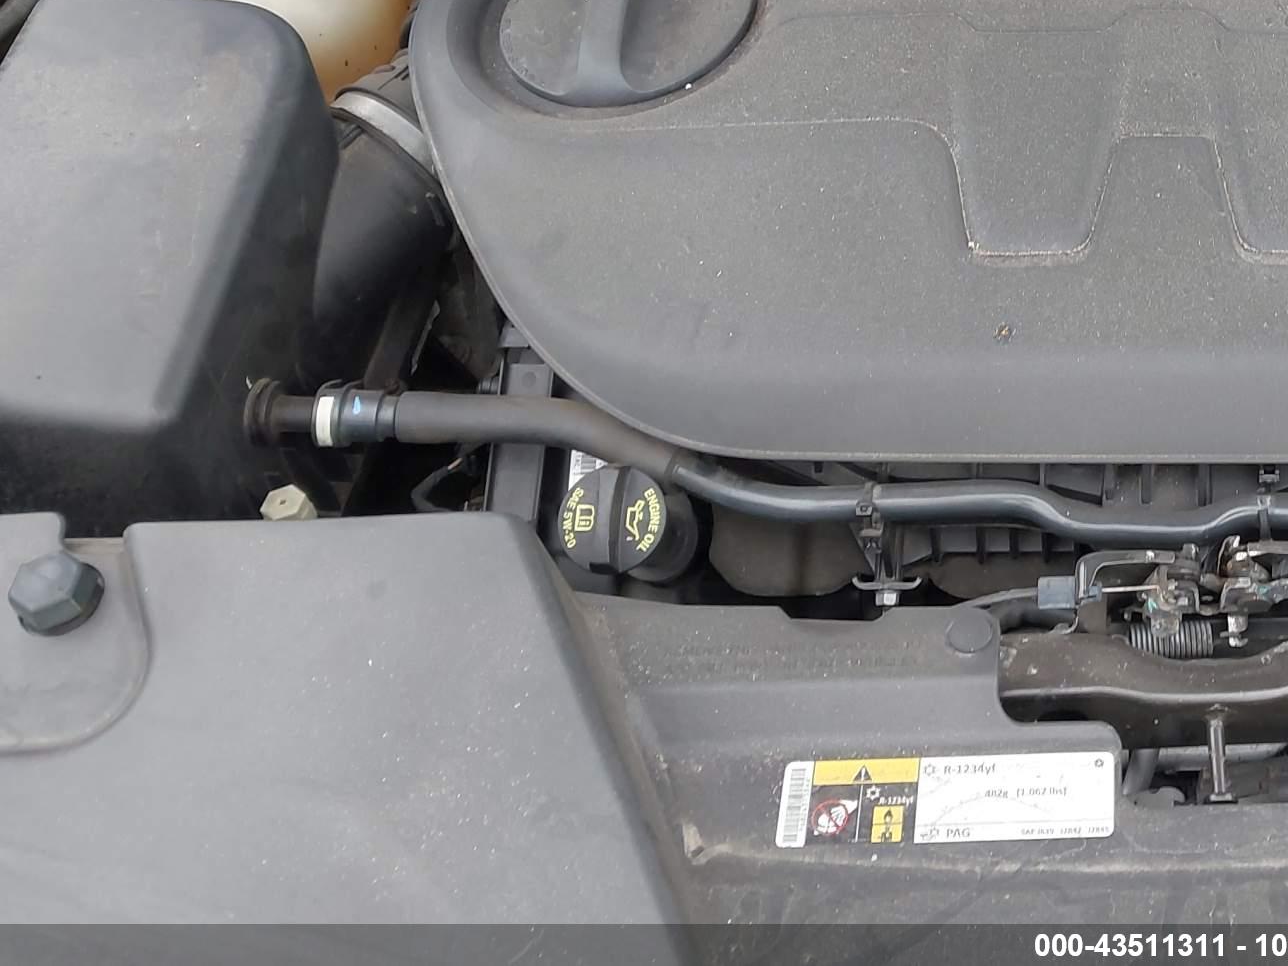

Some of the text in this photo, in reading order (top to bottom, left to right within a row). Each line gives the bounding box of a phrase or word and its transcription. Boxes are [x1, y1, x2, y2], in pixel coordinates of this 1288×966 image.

[562, 487, 584, 549] SAE 5W-20
[635, 488, 662, 553] ENGINE OIL
[944, 762, 996, 776] R-1234yf
[946, 827, 971, 838] PAG
